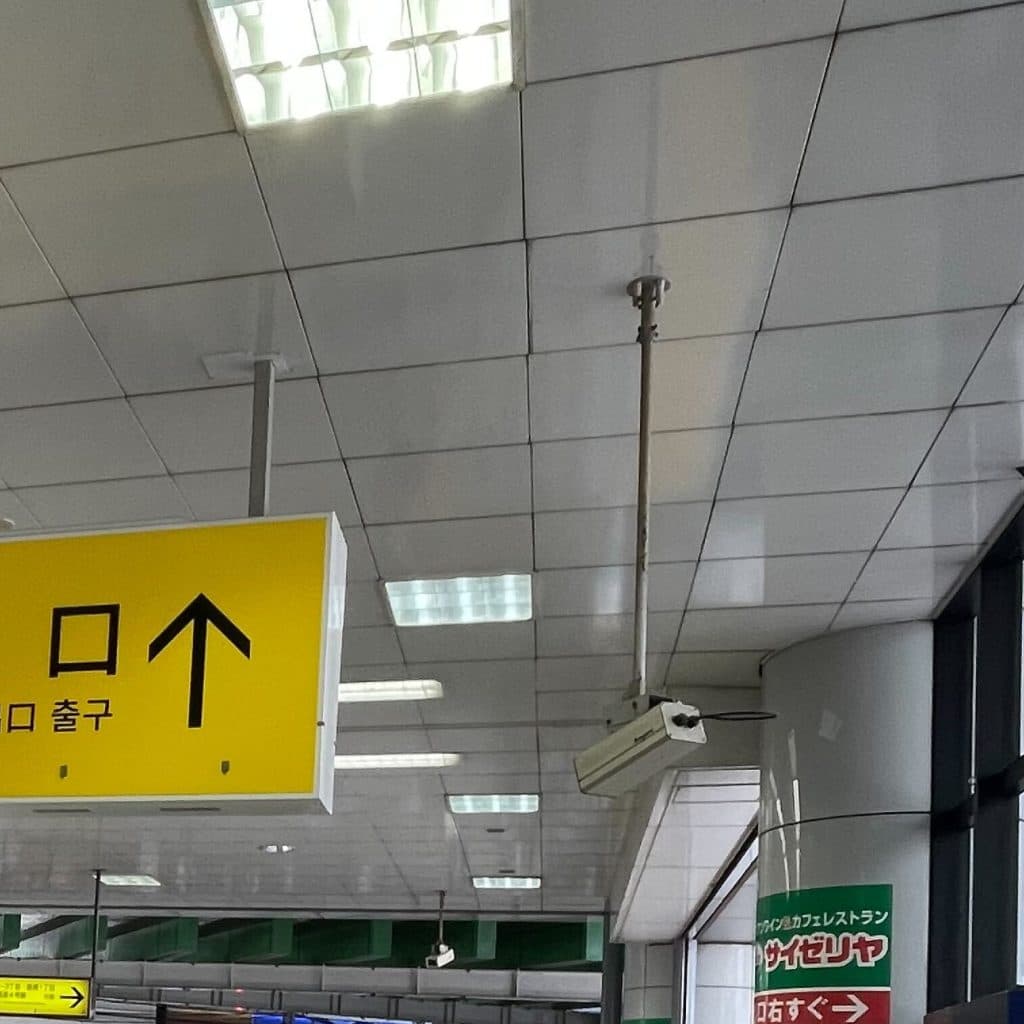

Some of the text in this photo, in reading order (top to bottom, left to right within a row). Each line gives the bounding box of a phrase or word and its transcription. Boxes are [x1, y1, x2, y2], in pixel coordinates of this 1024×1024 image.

[51, 699, 113, 732] 출구
[764, 932, 889, 972] サイゼリヤ
[757, 996, 829, 1023] 口右すぐ
